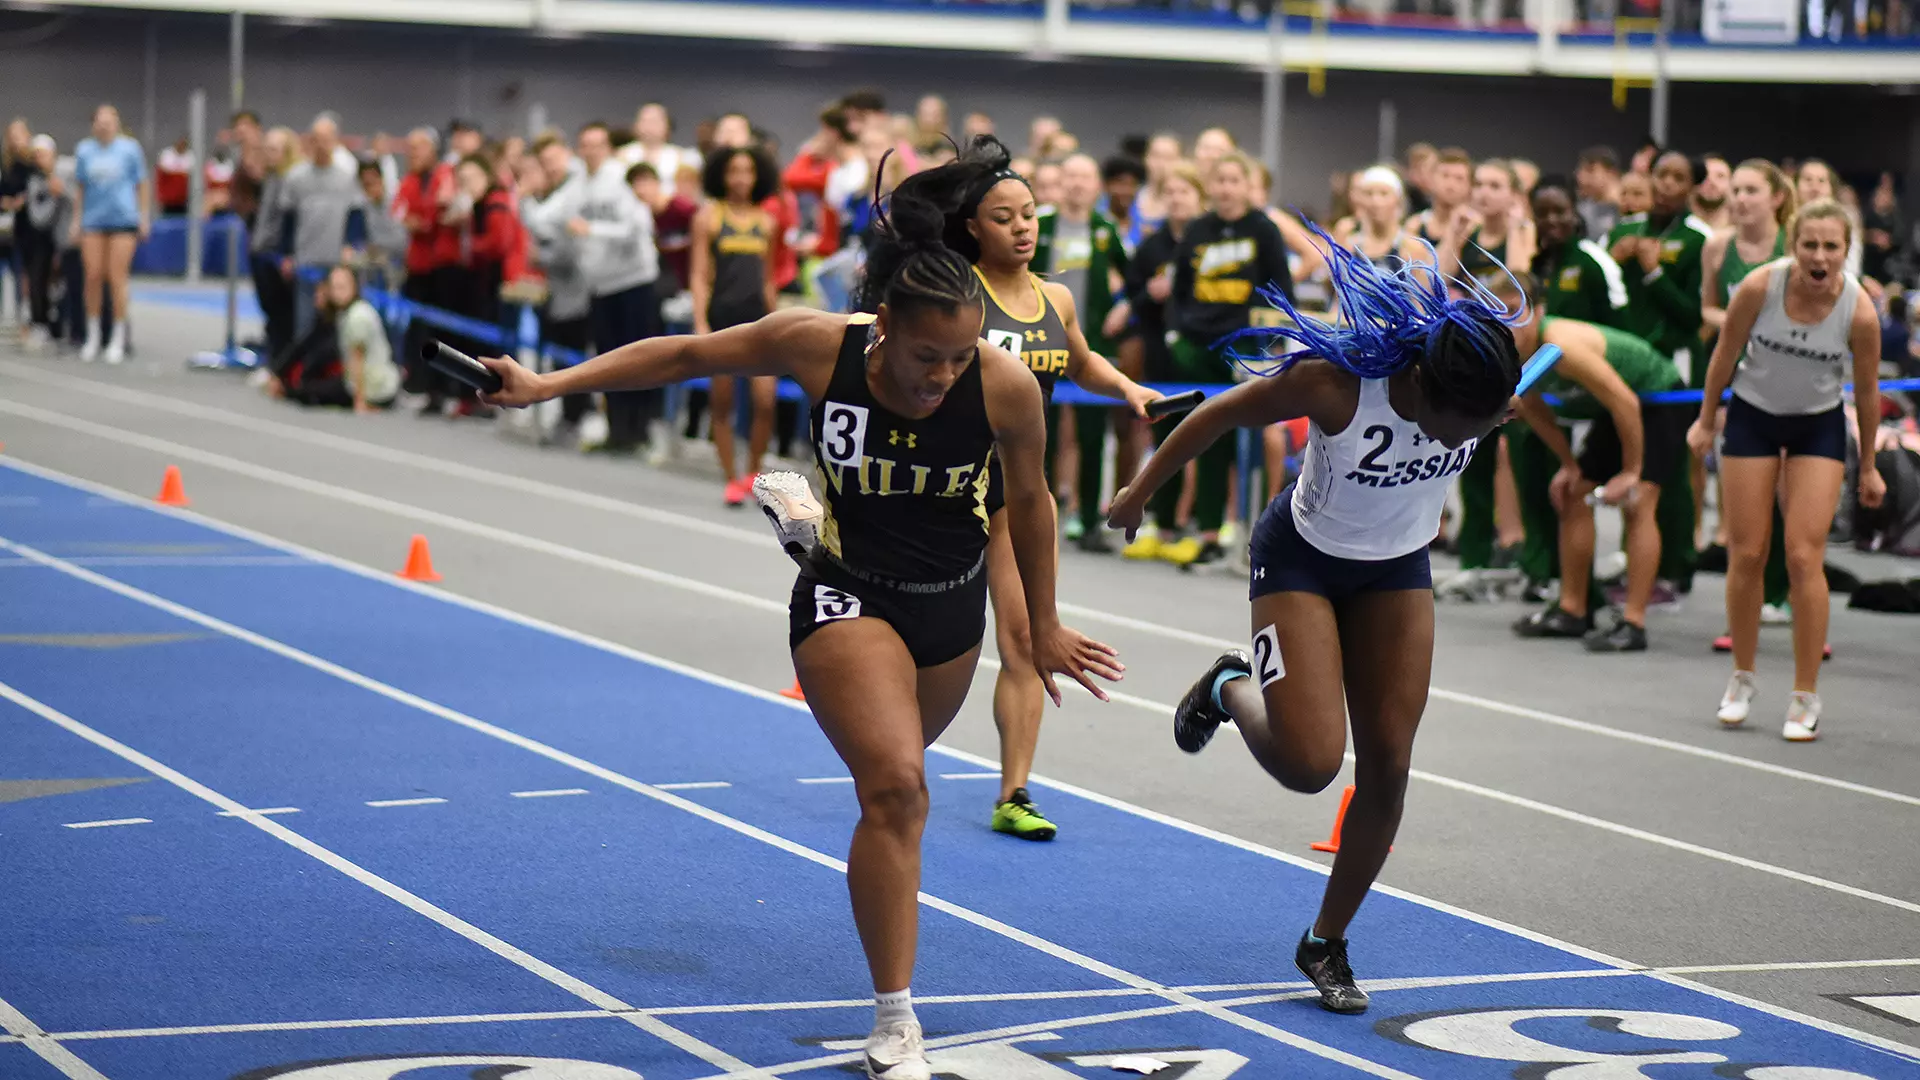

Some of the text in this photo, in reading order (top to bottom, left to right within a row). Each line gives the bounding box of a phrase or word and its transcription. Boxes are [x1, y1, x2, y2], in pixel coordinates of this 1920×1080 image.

[827, 408, 857, 461] 3
[1358, 424, 1393, 473] 2
[821, 590, 854, 617] 3
[897, 582, 947, 594] ARMOUR
[1255, 635, 1279, 685] 2
